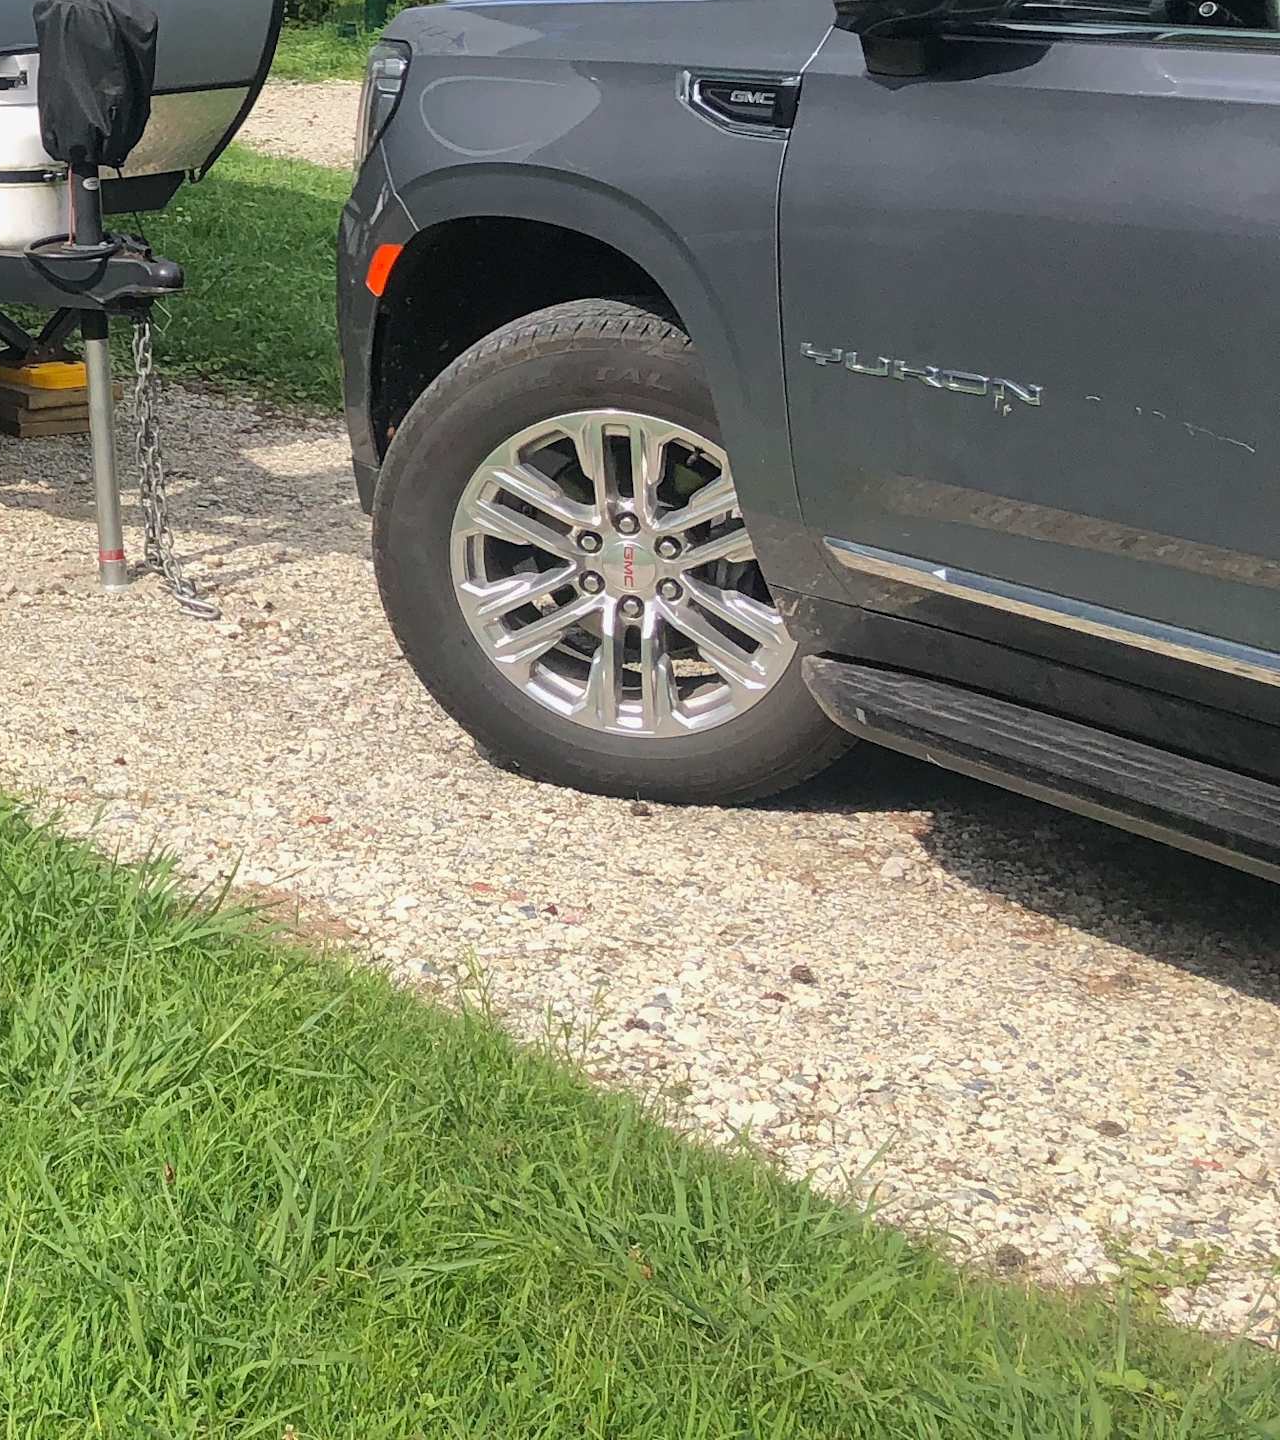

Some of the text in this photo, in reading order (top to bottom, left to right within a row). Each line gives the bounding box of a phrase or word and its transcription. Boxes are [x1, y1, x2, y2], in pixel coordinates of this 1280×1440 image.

[729, 90, 776, 105] GMC
[800, 342, 1043, 406] YUKON
[623, 545, 635, 588] GMC
